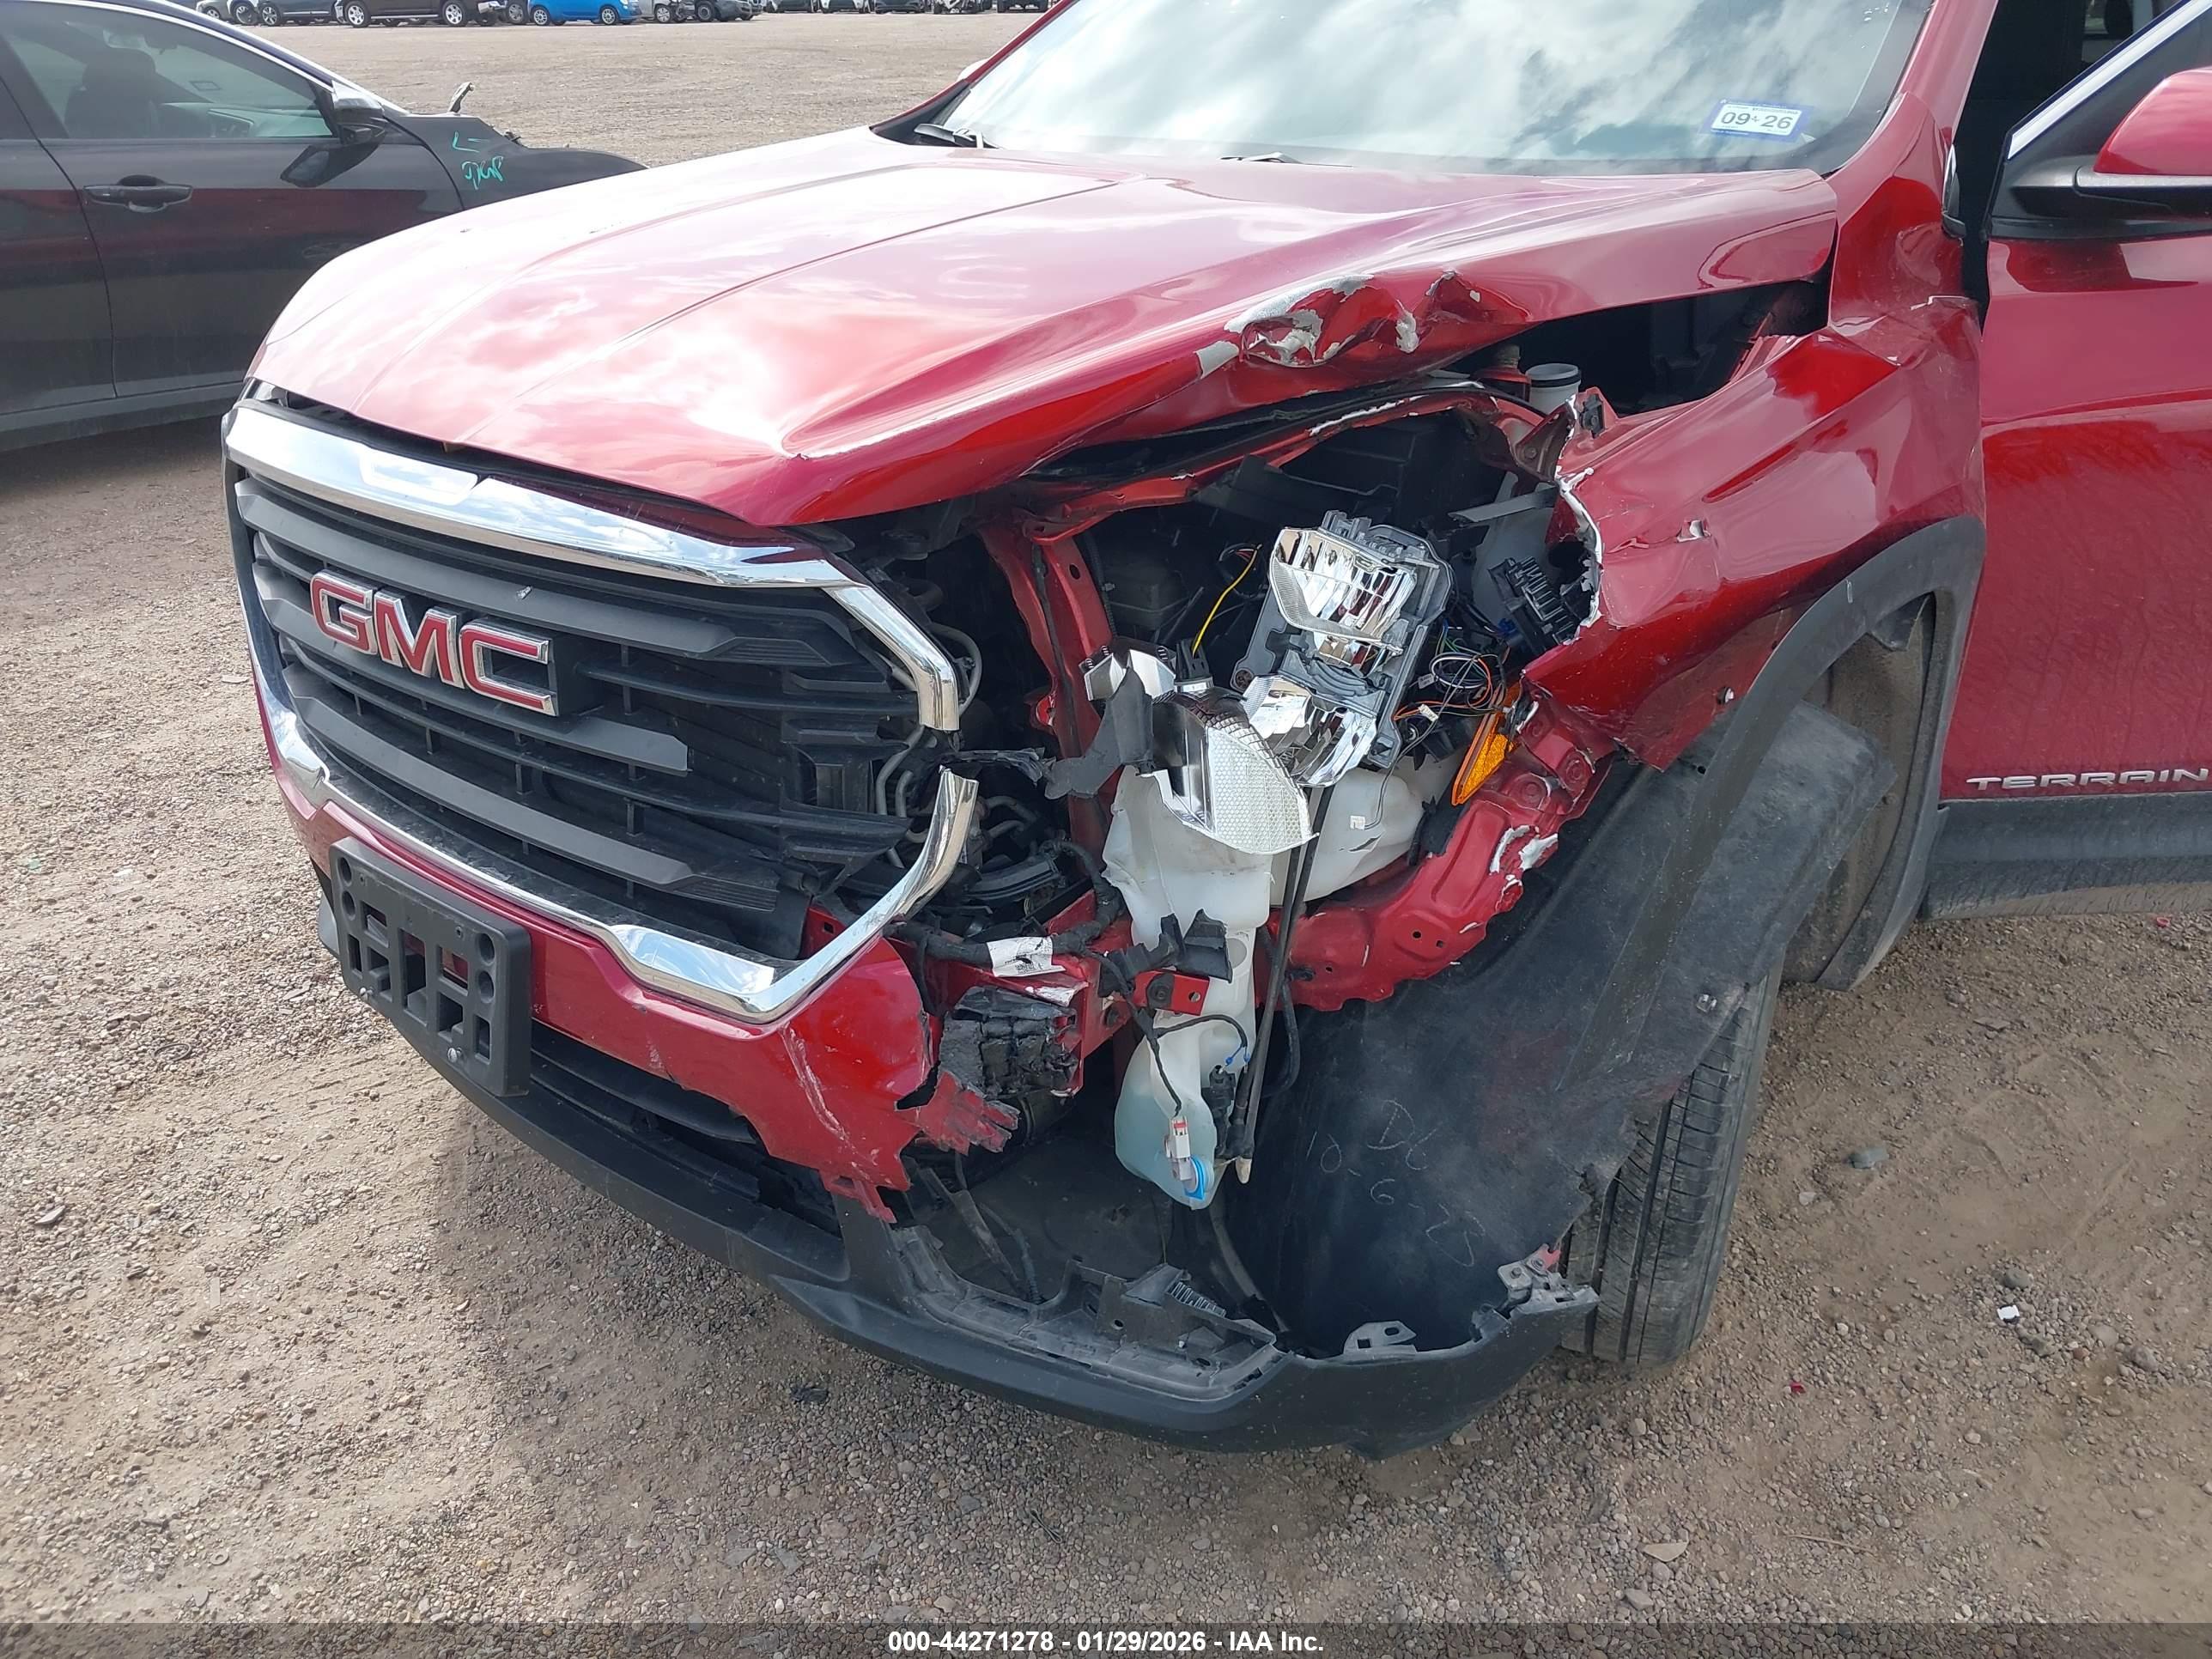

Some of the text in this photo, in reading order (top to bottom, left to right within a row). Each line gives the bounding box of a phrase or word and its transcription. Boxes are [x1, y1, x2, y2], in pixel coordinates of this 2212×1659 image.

[1721, 112, 1793, 129] 09 26
[309, 568, 560, 717] GMC
[1966, 768, 2209, 791] TERRAIN
